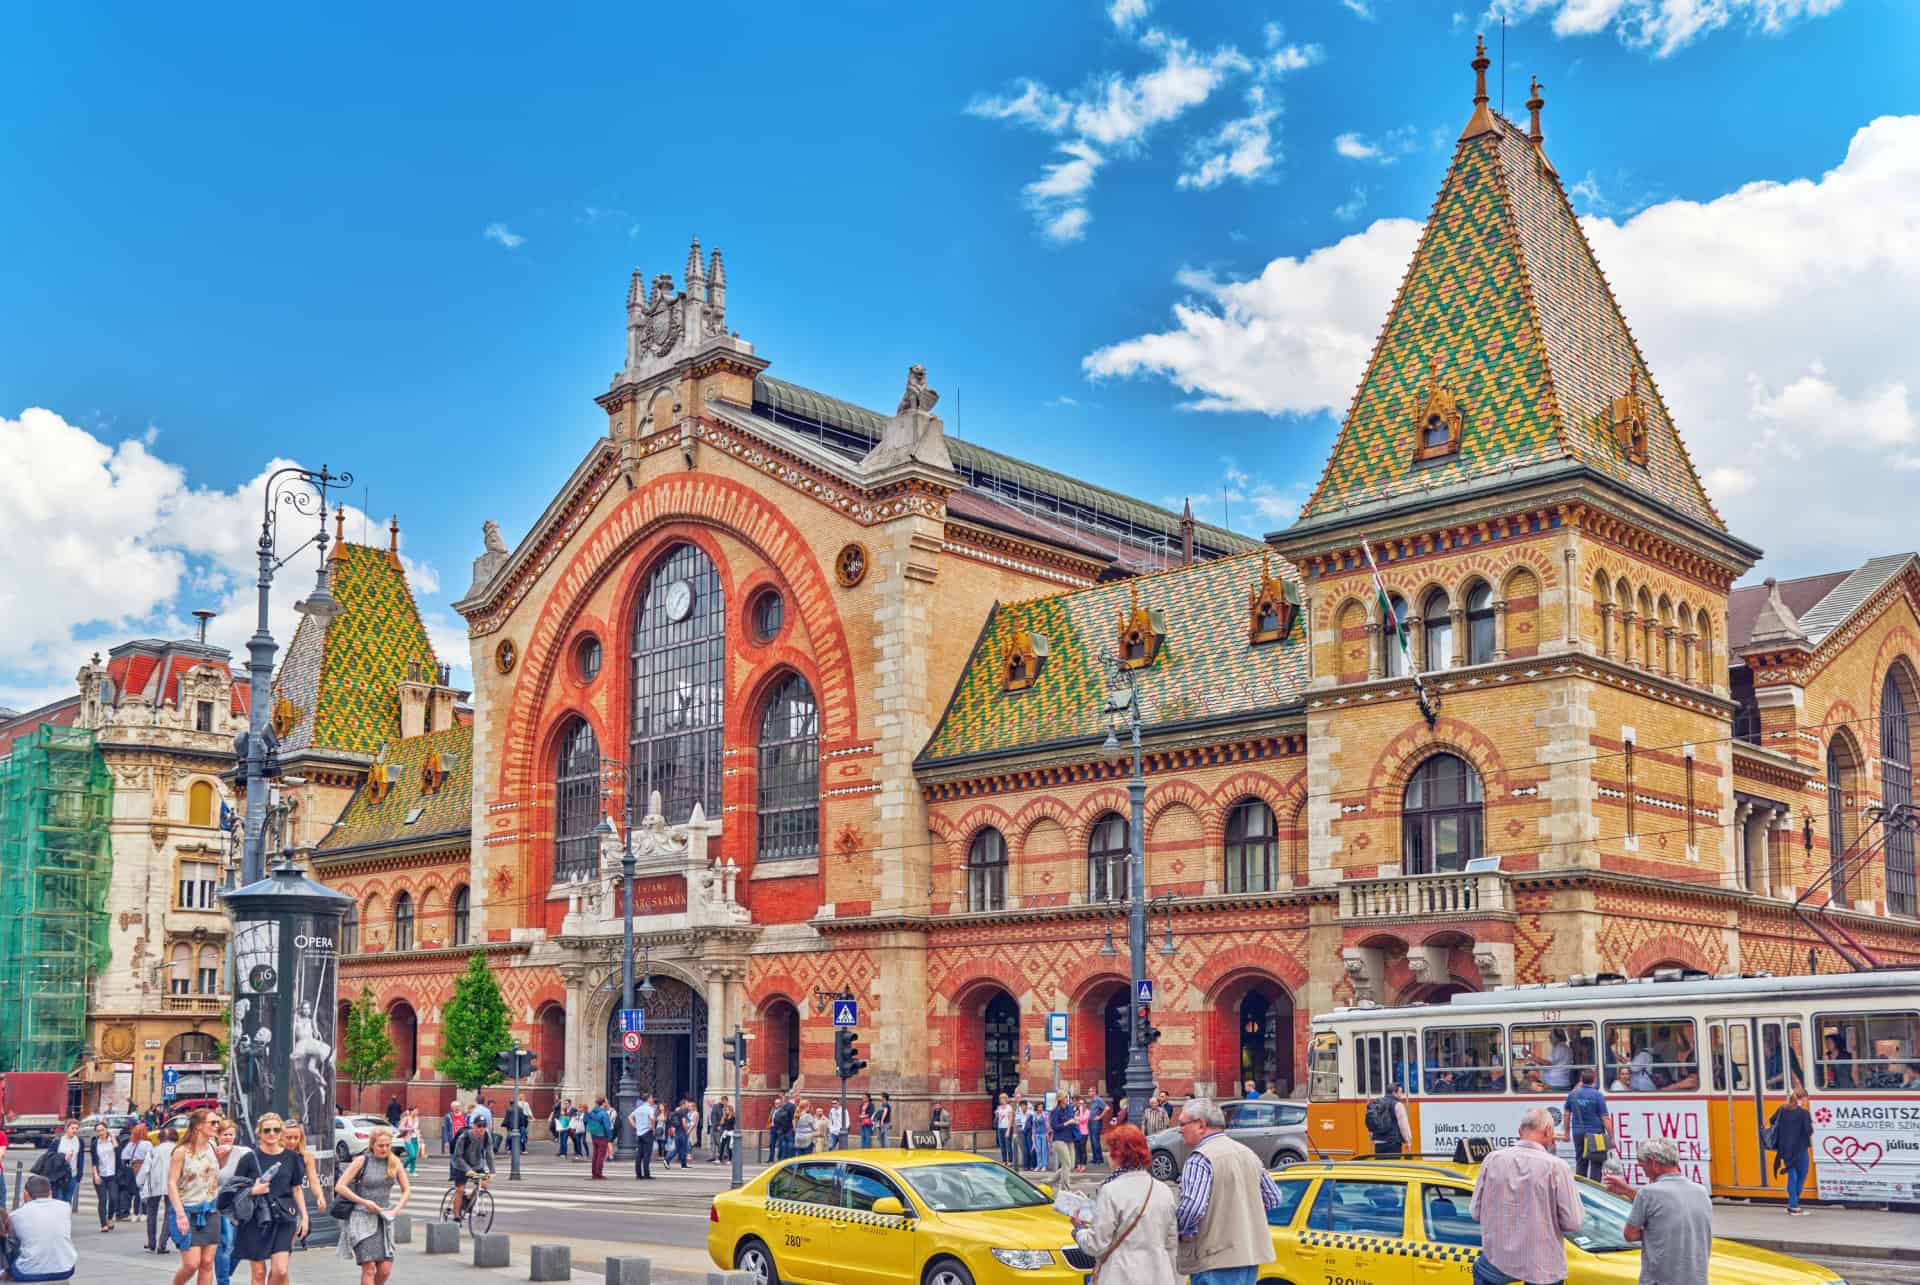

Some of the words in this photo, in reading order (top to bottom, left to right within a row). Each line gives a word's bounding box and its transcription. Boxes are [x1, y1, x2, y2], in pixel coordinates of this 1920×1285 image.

[294, 933, 333, 948] OPERA
[1836, 1107, 1920, 1120] MARGITSZ
[1434, 1122, 1459, 1134] július
[1470, 1123, 1496, 1133] 20:00
[1641, 1112, 1698, 1139] TWO
[913, 1135, 936, 1145] TAXI
[1886, 1139, 1919, 1152] július
[1470, 1144, 1491, 1157] TAXI
[785, 1234, 801, 1248] 280
